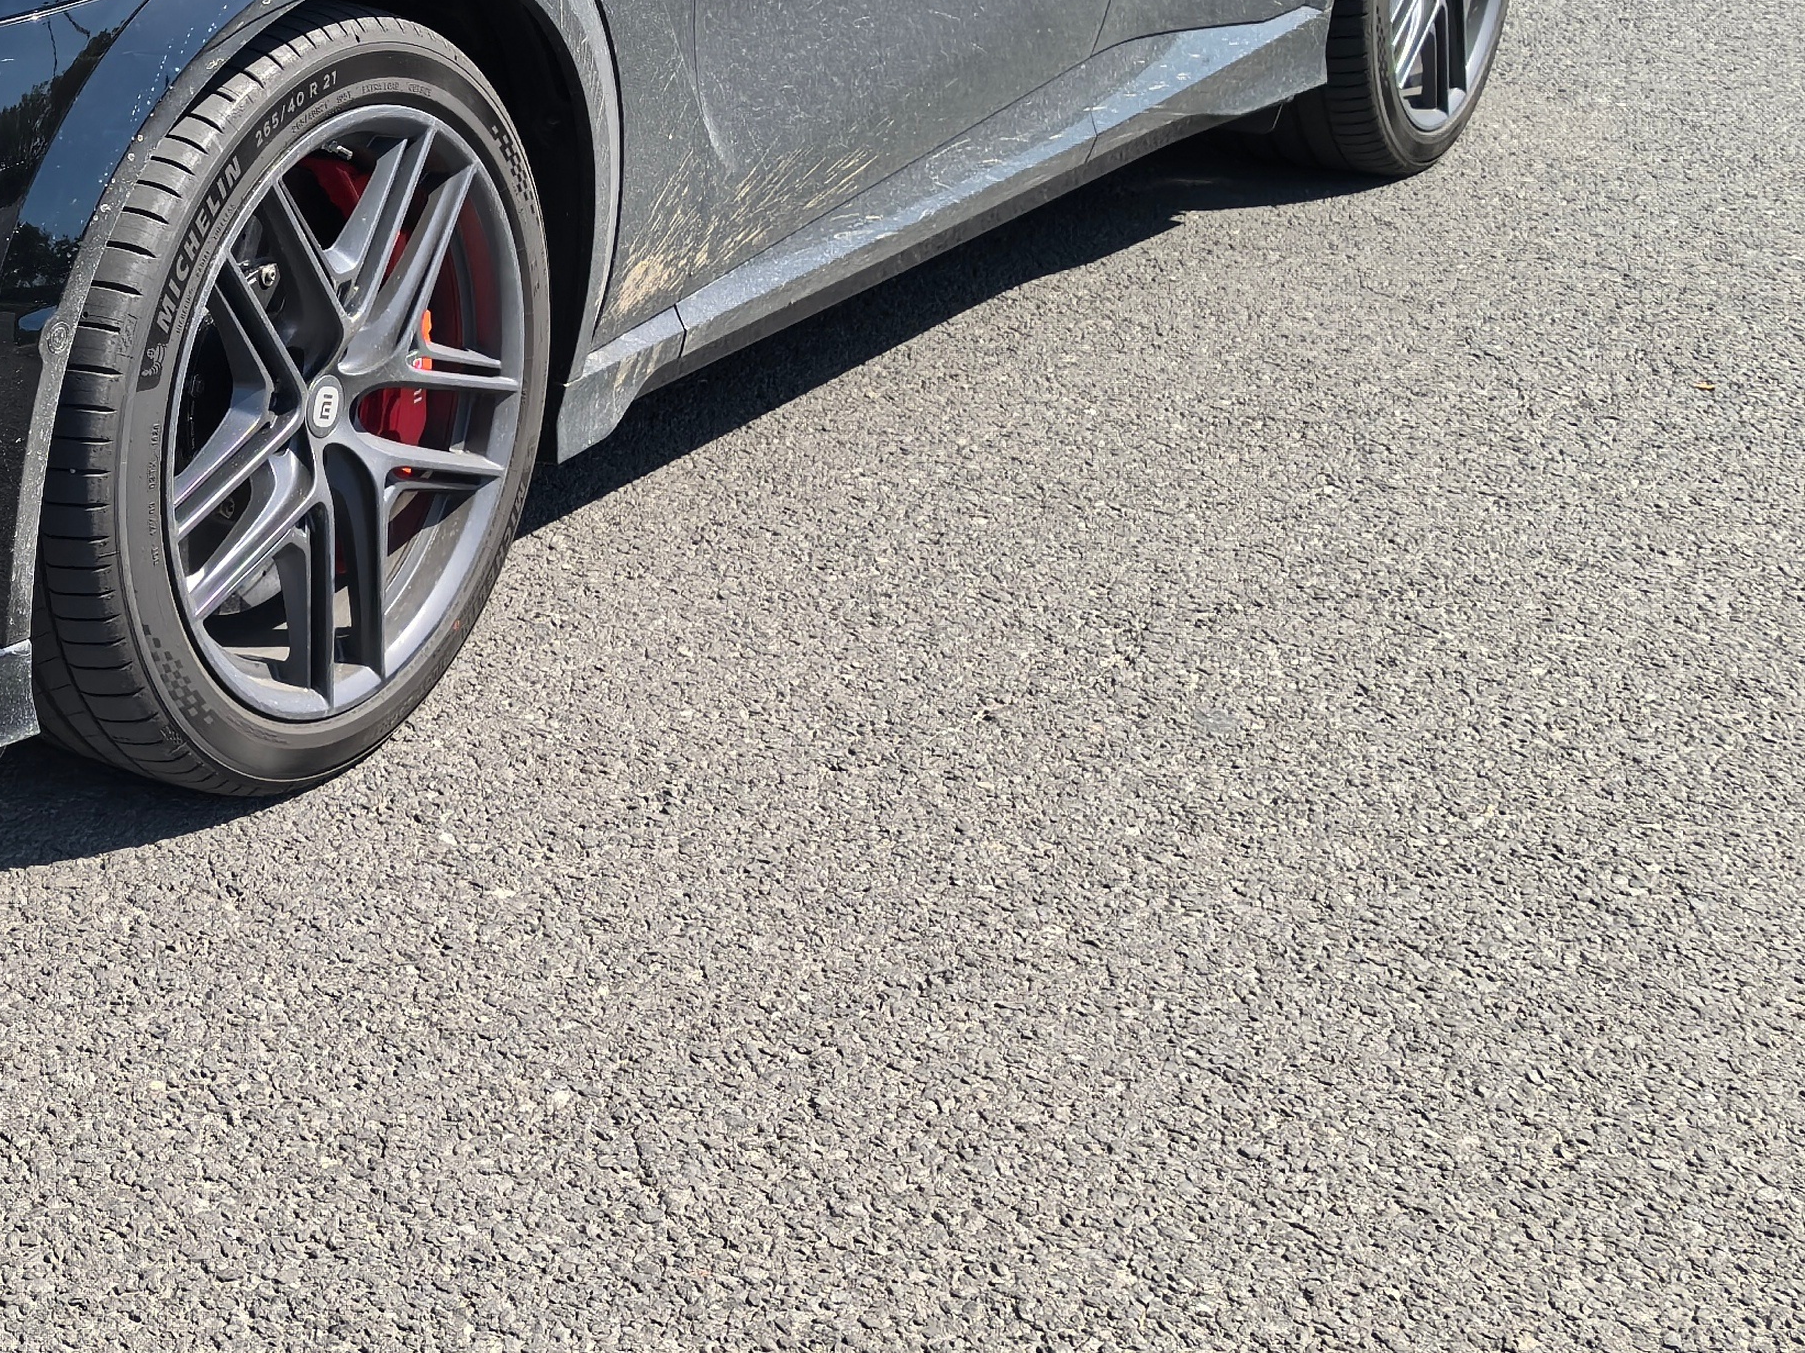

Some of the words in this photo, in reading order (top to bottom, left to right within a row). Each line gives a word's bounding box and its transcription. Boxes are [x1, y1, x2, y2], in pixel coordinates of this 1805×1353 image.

[154, 155, 243, 336] MICHELIN
[252, 91, 305, 148] 265/40
[309, 82, 319, 99] R
[322, 69, 339, 91] 21
